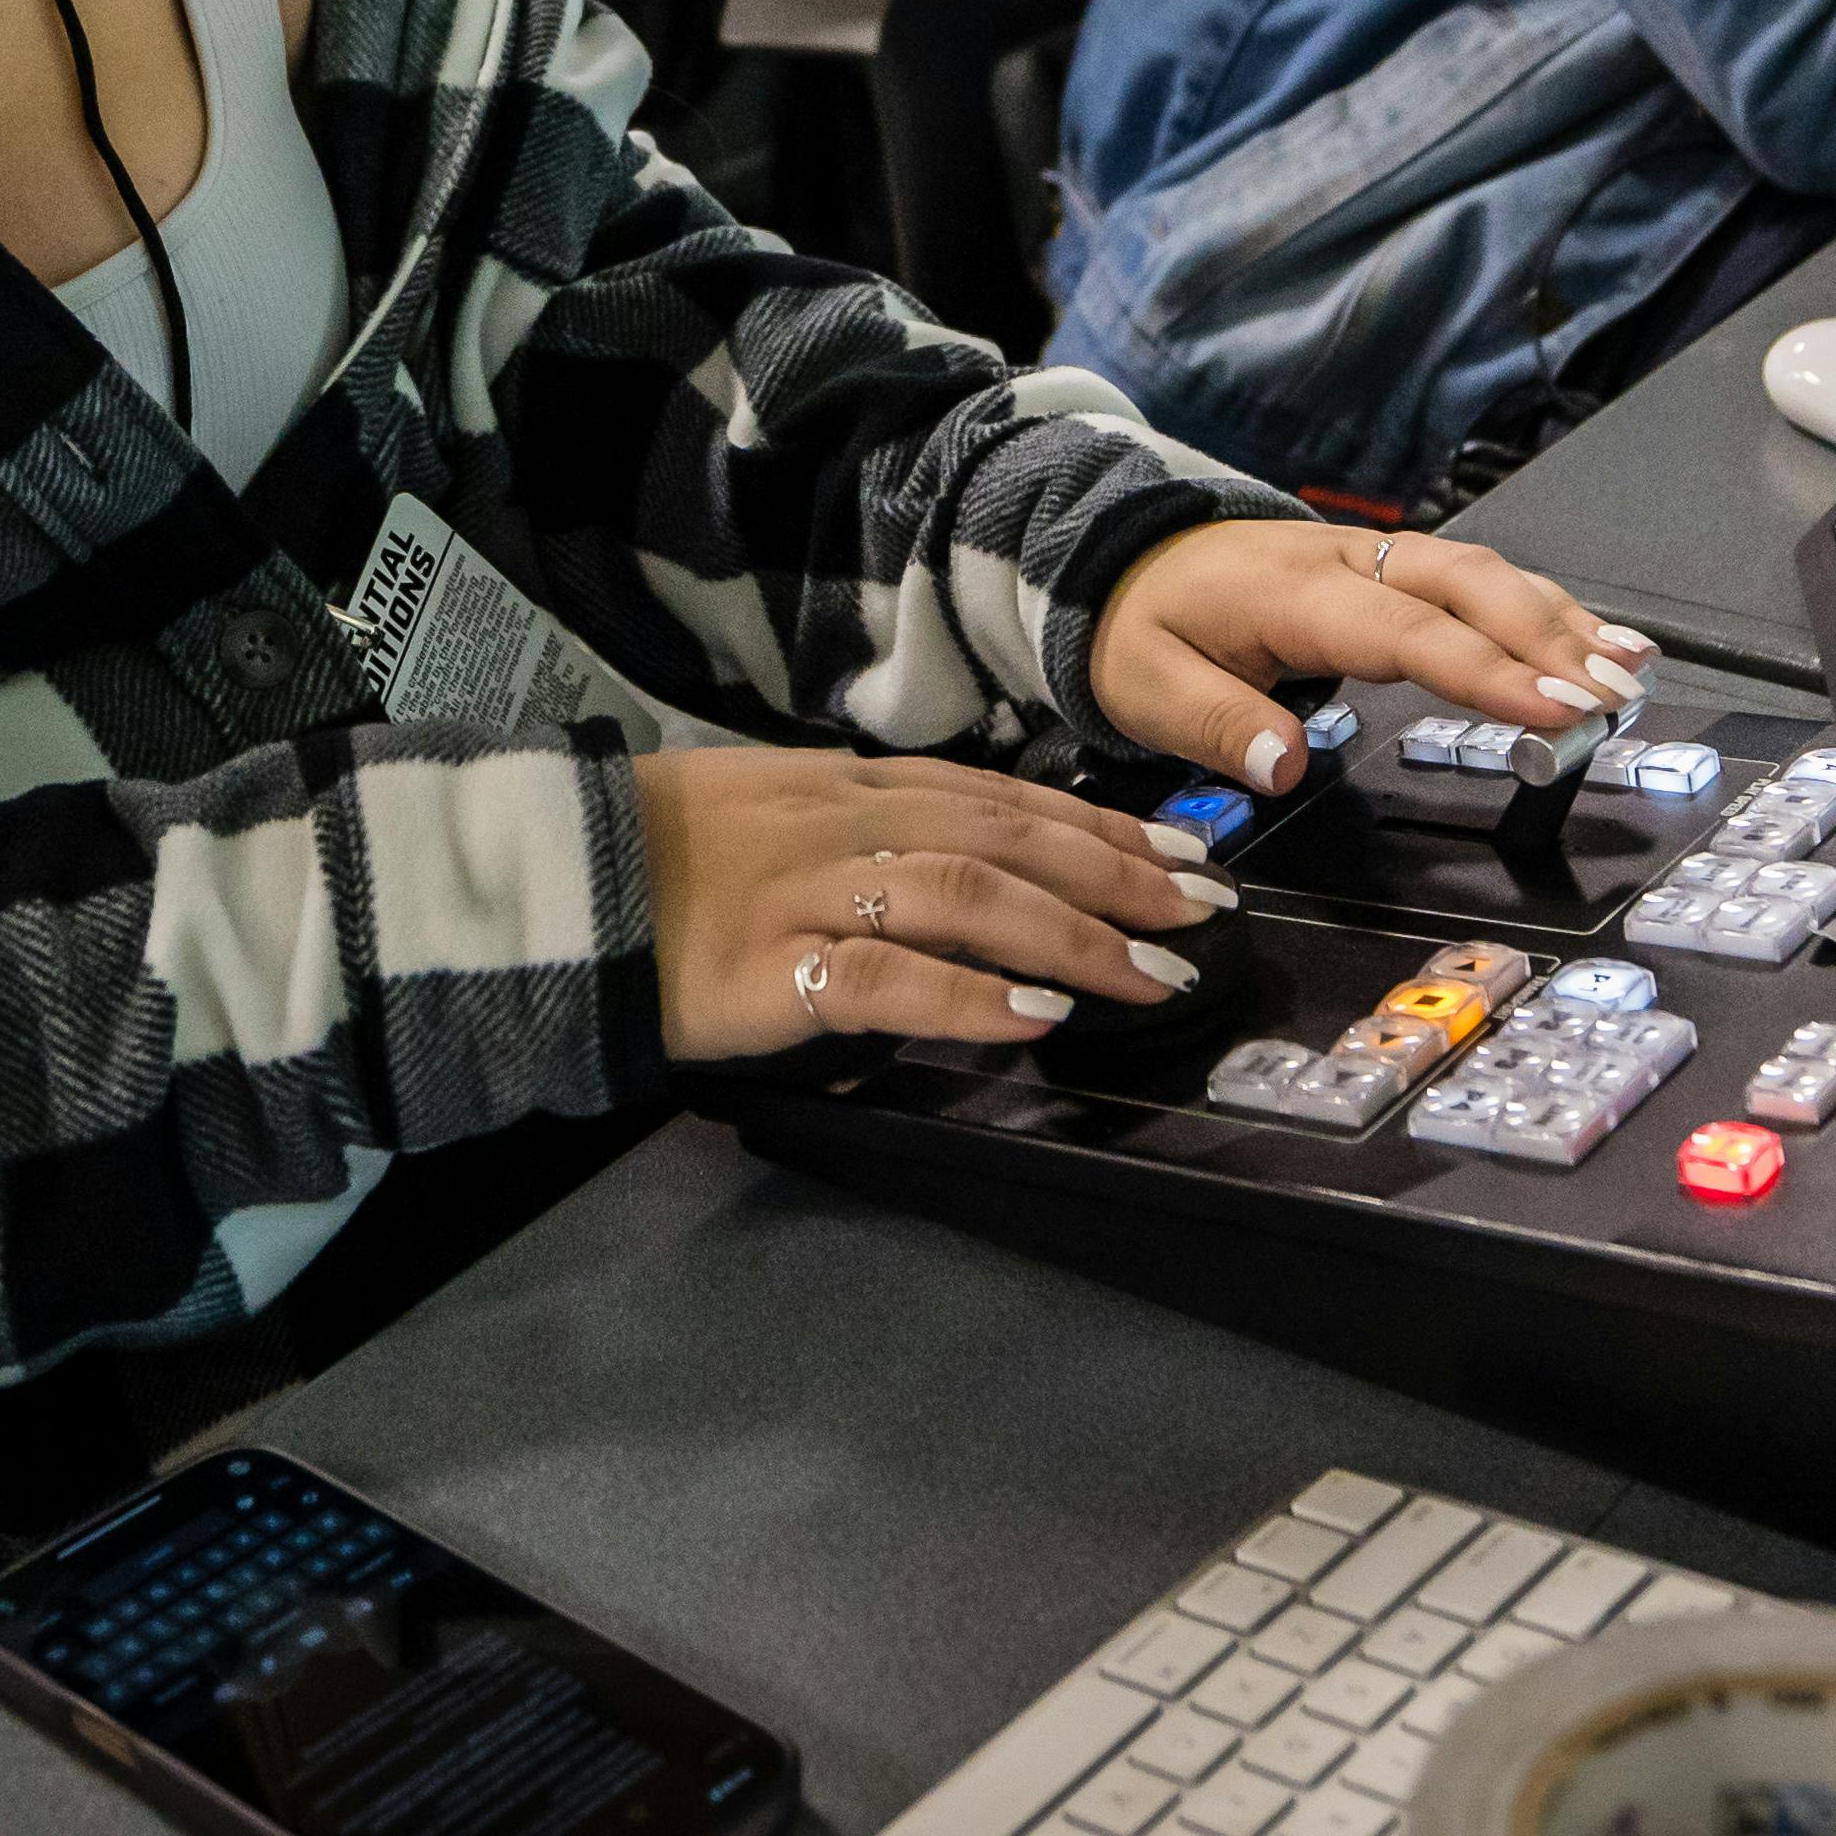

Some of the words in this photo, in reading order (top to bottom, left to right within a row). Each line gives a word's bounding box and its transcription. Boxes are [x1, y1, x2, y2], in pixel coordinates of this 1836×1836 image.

[404, 622, 439, 688] credential
[415, 646, 439, 688] bearer
[433, 618, 450, 645] and
[443, 572, 469, 618] his/her
[416, 679, 437, 716] abide
[447, 575, 480, 637] foregoing
[446, 664, 464, 694] that
[466, 579, 499, 641] published
[454, 625, 491, 697] credentials
[483, 580, 508, 624] remain
[458, 592, 483, 636] placed
[464, 642, 494, 697] Missouri
[487, 604, 508, 640] State
[469, 634, 509, 712] surrendered
[501, 601, 521, 634] upon
[491, 631, 519, 683] children
[529, 658, 547, 688] AND
[539, 628, 558, 659] MAY
